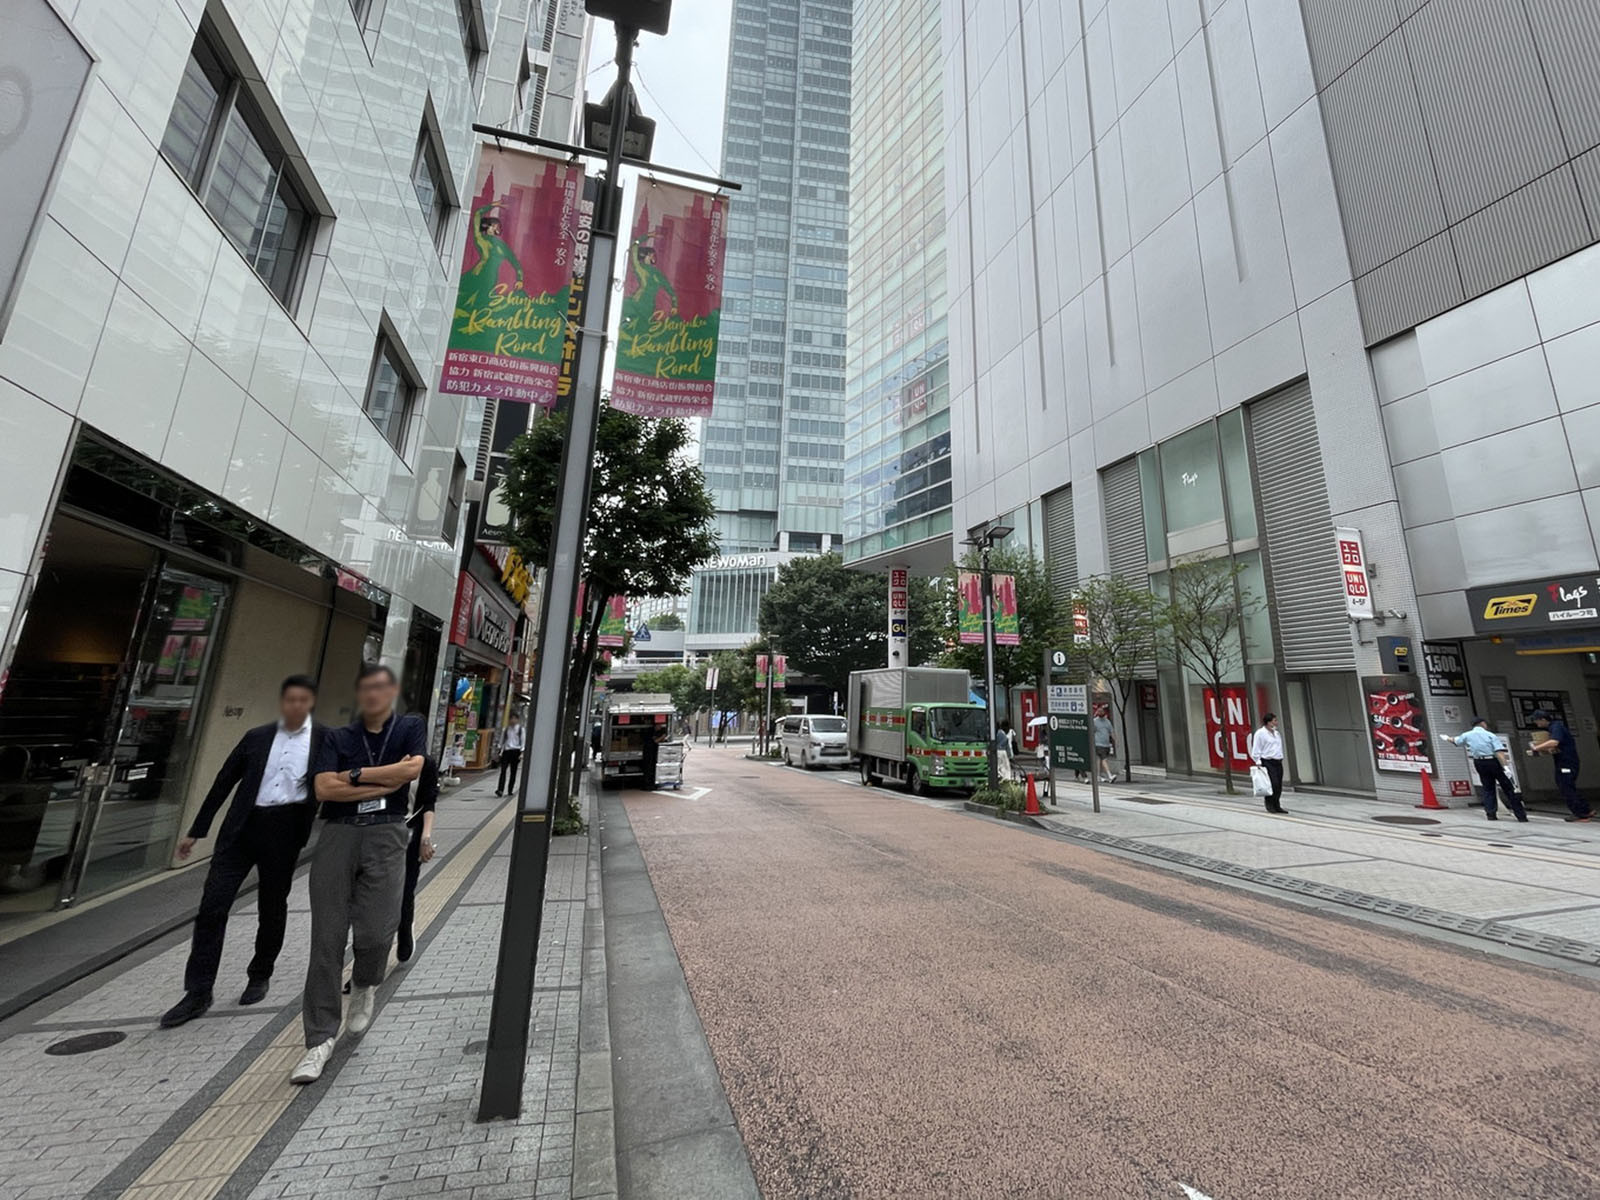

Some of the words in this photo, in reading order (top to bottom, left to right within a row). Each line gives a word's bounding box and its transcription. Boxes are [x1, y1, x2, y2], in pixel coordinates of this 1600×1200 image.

[488, 283, 556, 312] Shinjuku
[468, 308, 561, 338] Rambling
[631, 332, 713, 357] Rambling
[446, 380, 538, 398] 防犯カメラ作動中
[481, 528, 506, 537] Aeso
[1347, 573, 1363, 584] UNI
[1349, 584, 1366, 595] QLO
[1491, 598, 1533, 616] Times
